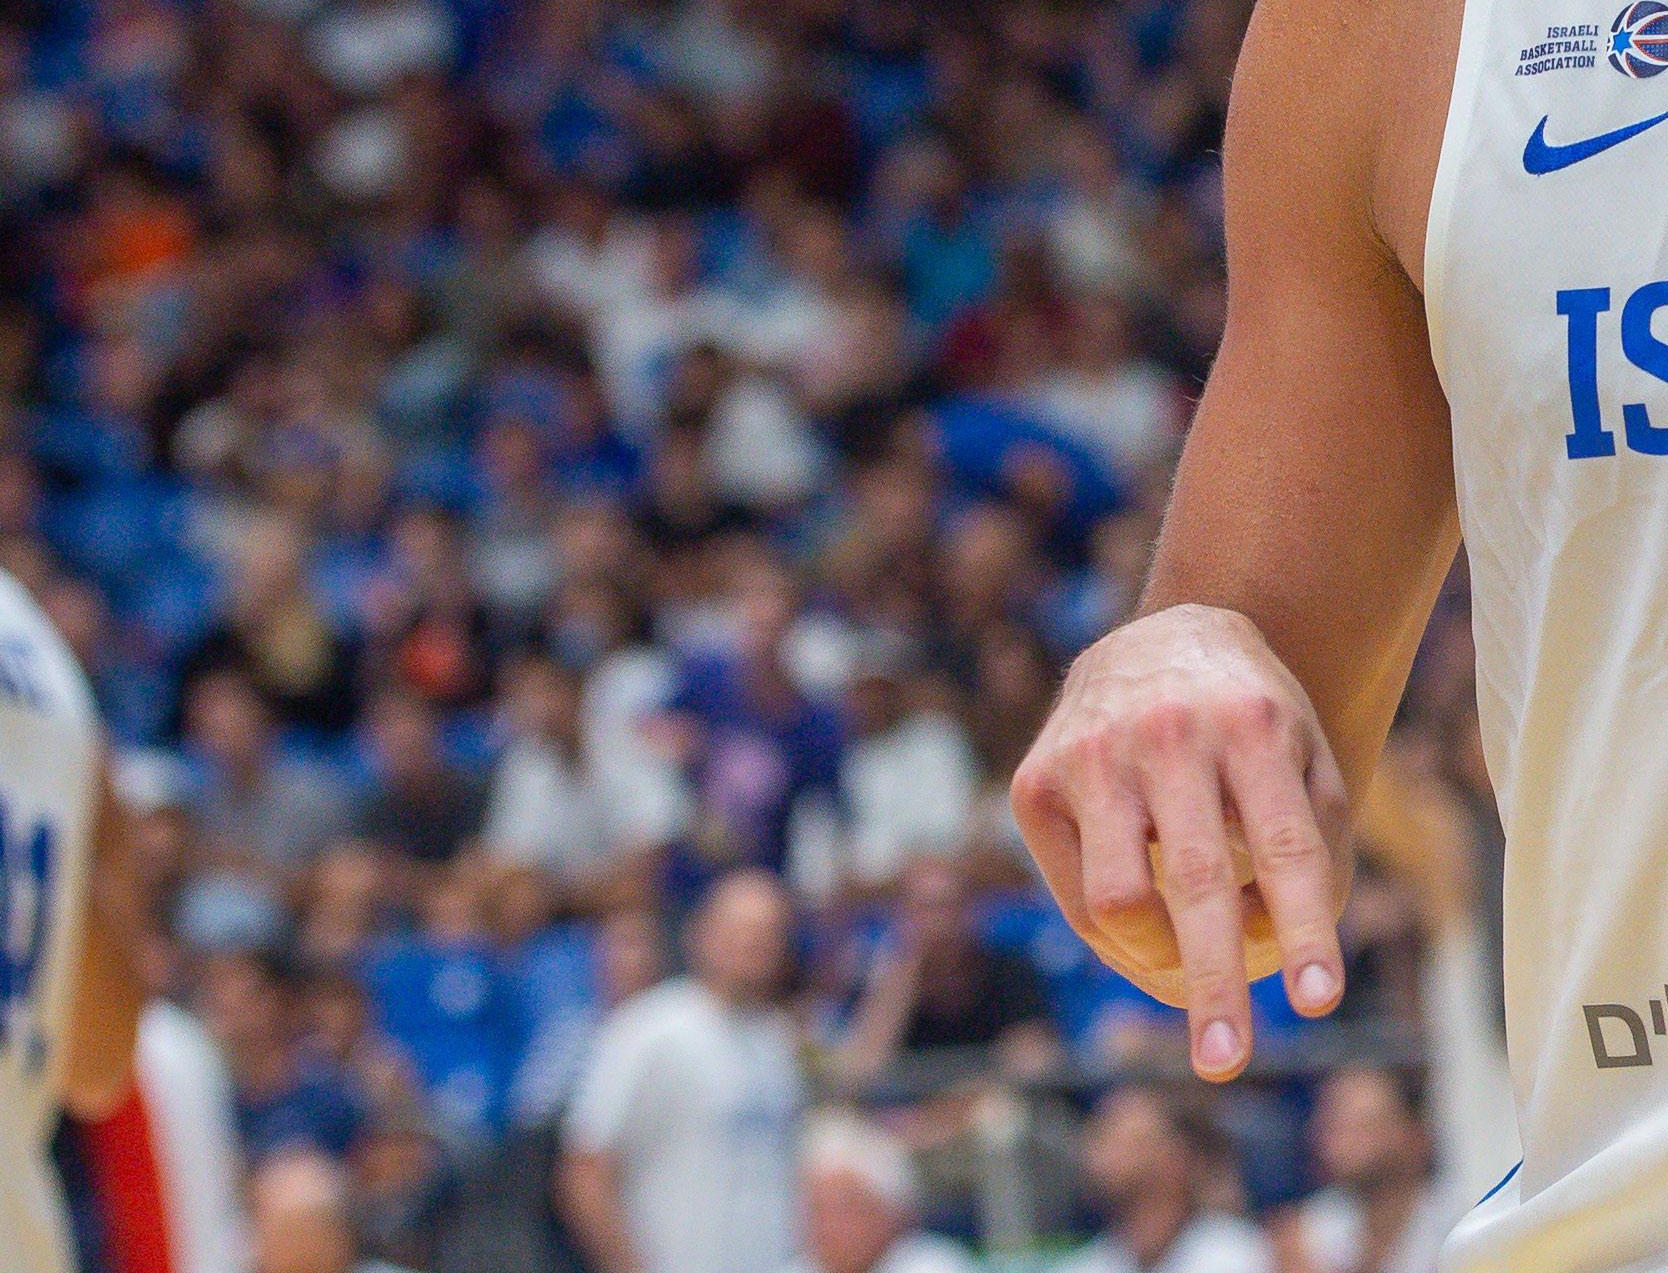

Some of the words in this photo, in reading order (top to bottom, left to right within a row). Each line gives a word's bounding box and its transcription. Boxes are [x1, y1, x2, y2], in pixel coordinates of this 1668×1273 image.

[1547, 25, 1599, 39] ISRAELI
[1520, 40, 1597, 61] BASKETBALL
[1515, 56, 1595, 76] ASSOCIATION
